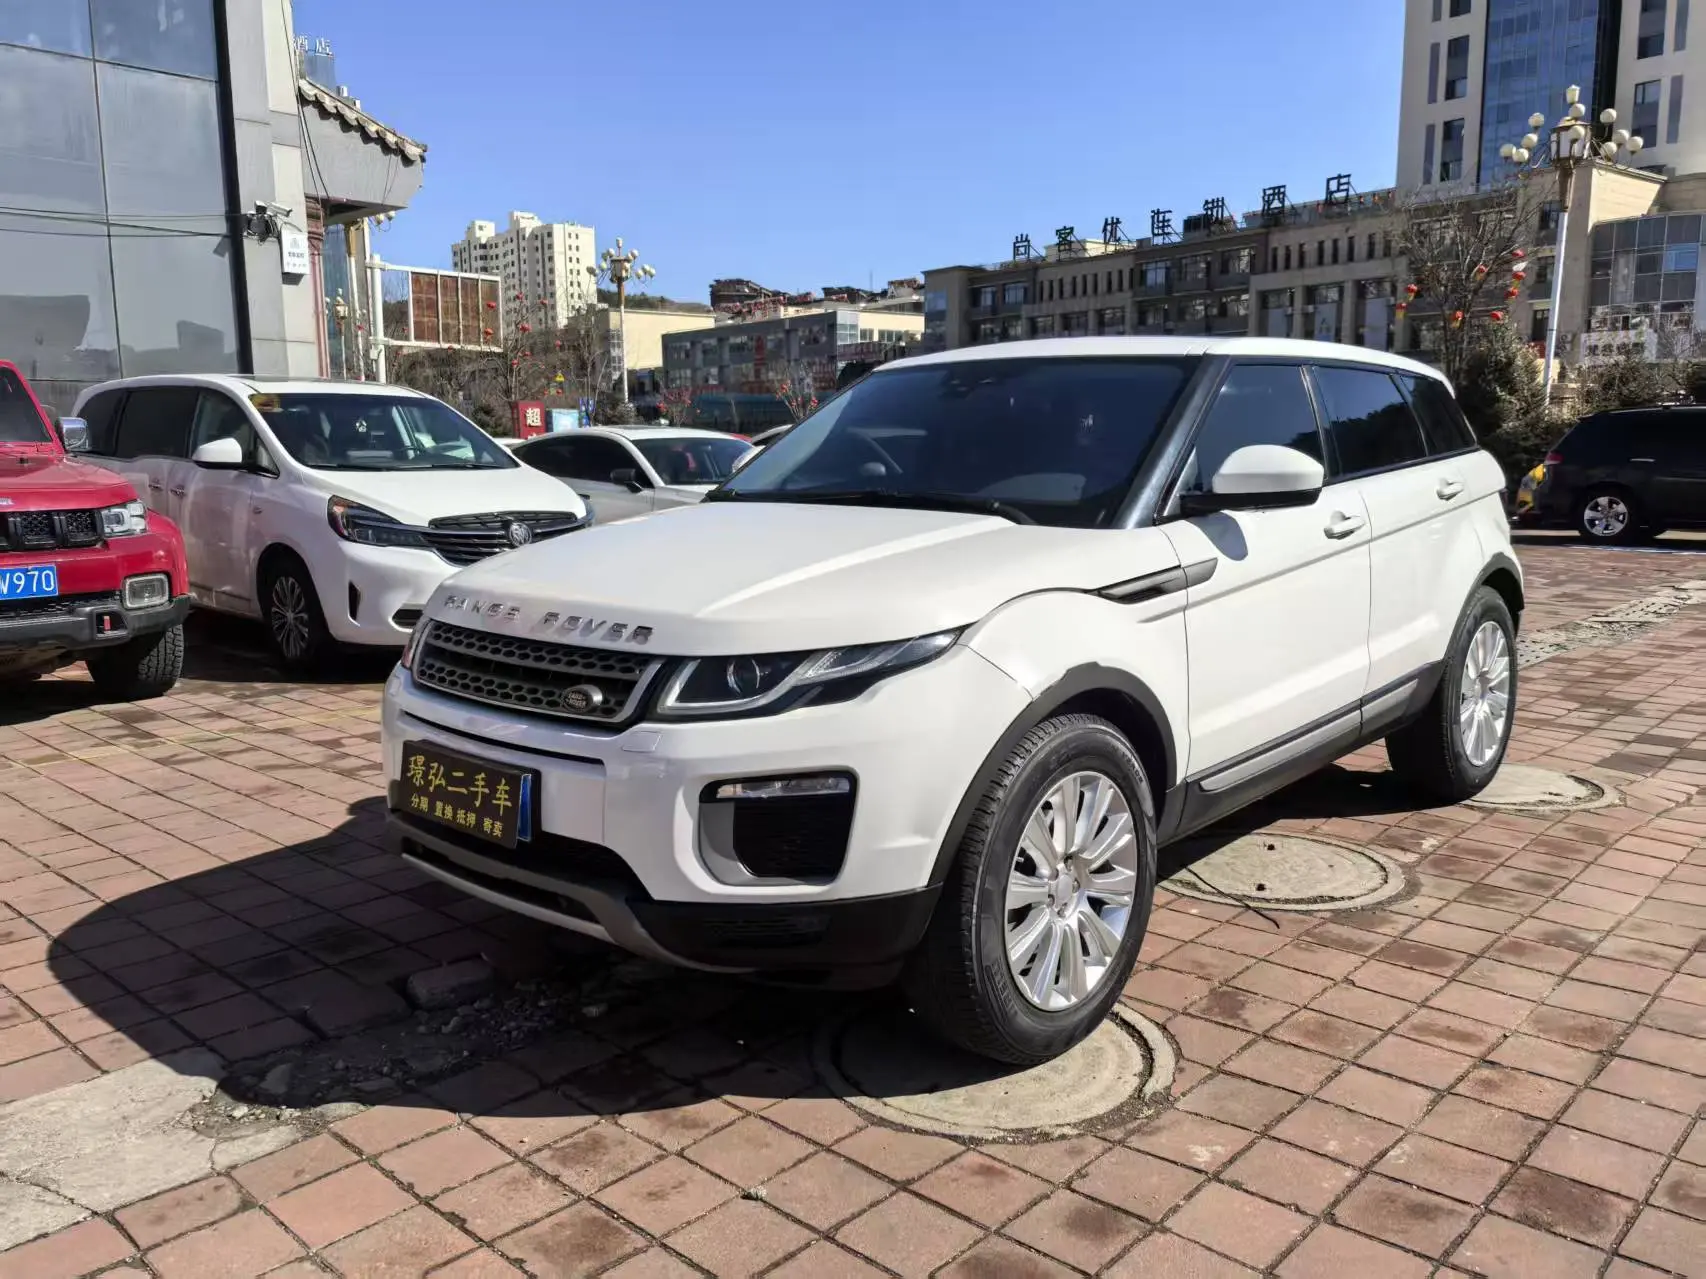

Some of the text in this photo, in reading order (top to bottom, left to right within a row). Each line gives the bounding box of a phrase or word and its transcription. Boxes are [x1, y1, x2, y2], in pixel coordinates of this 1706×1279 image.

[445, 595, 653, 643] RANGE ROVER
[407, 755, 512, 816] 璟弘二手车
[411, 793, 429, 812] 分期
[434, 801, 454, 820] 置换
[483, 817, 504, 837] 寄卖
